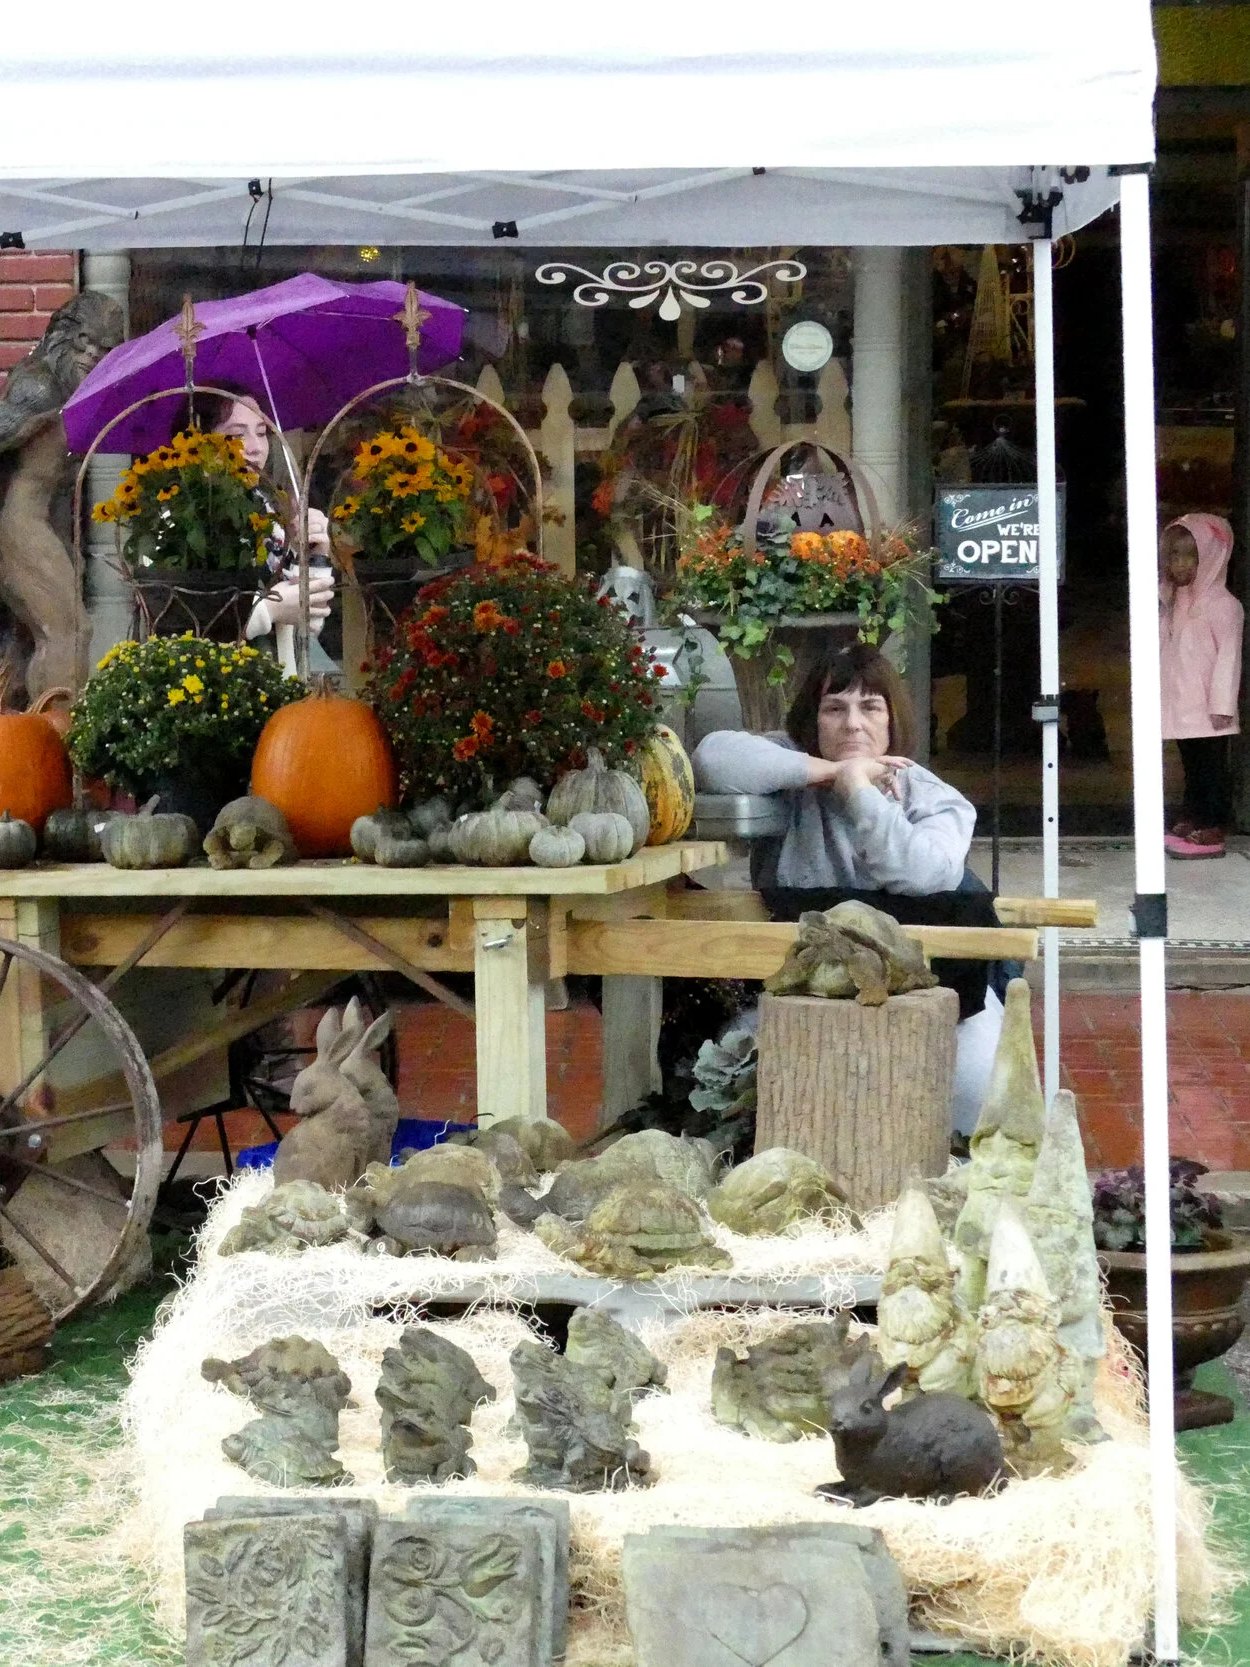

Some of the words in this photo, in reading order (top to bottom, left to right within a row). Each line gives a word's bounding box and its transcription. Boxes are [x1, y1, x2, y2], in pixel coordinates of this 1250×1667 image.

[951, 505, 1006, 529] Come
[1009, 494, 1034, 510] in
[997, 522, 1040, 536] WE'RE
[957, 540, 1037, 564] OPEN
